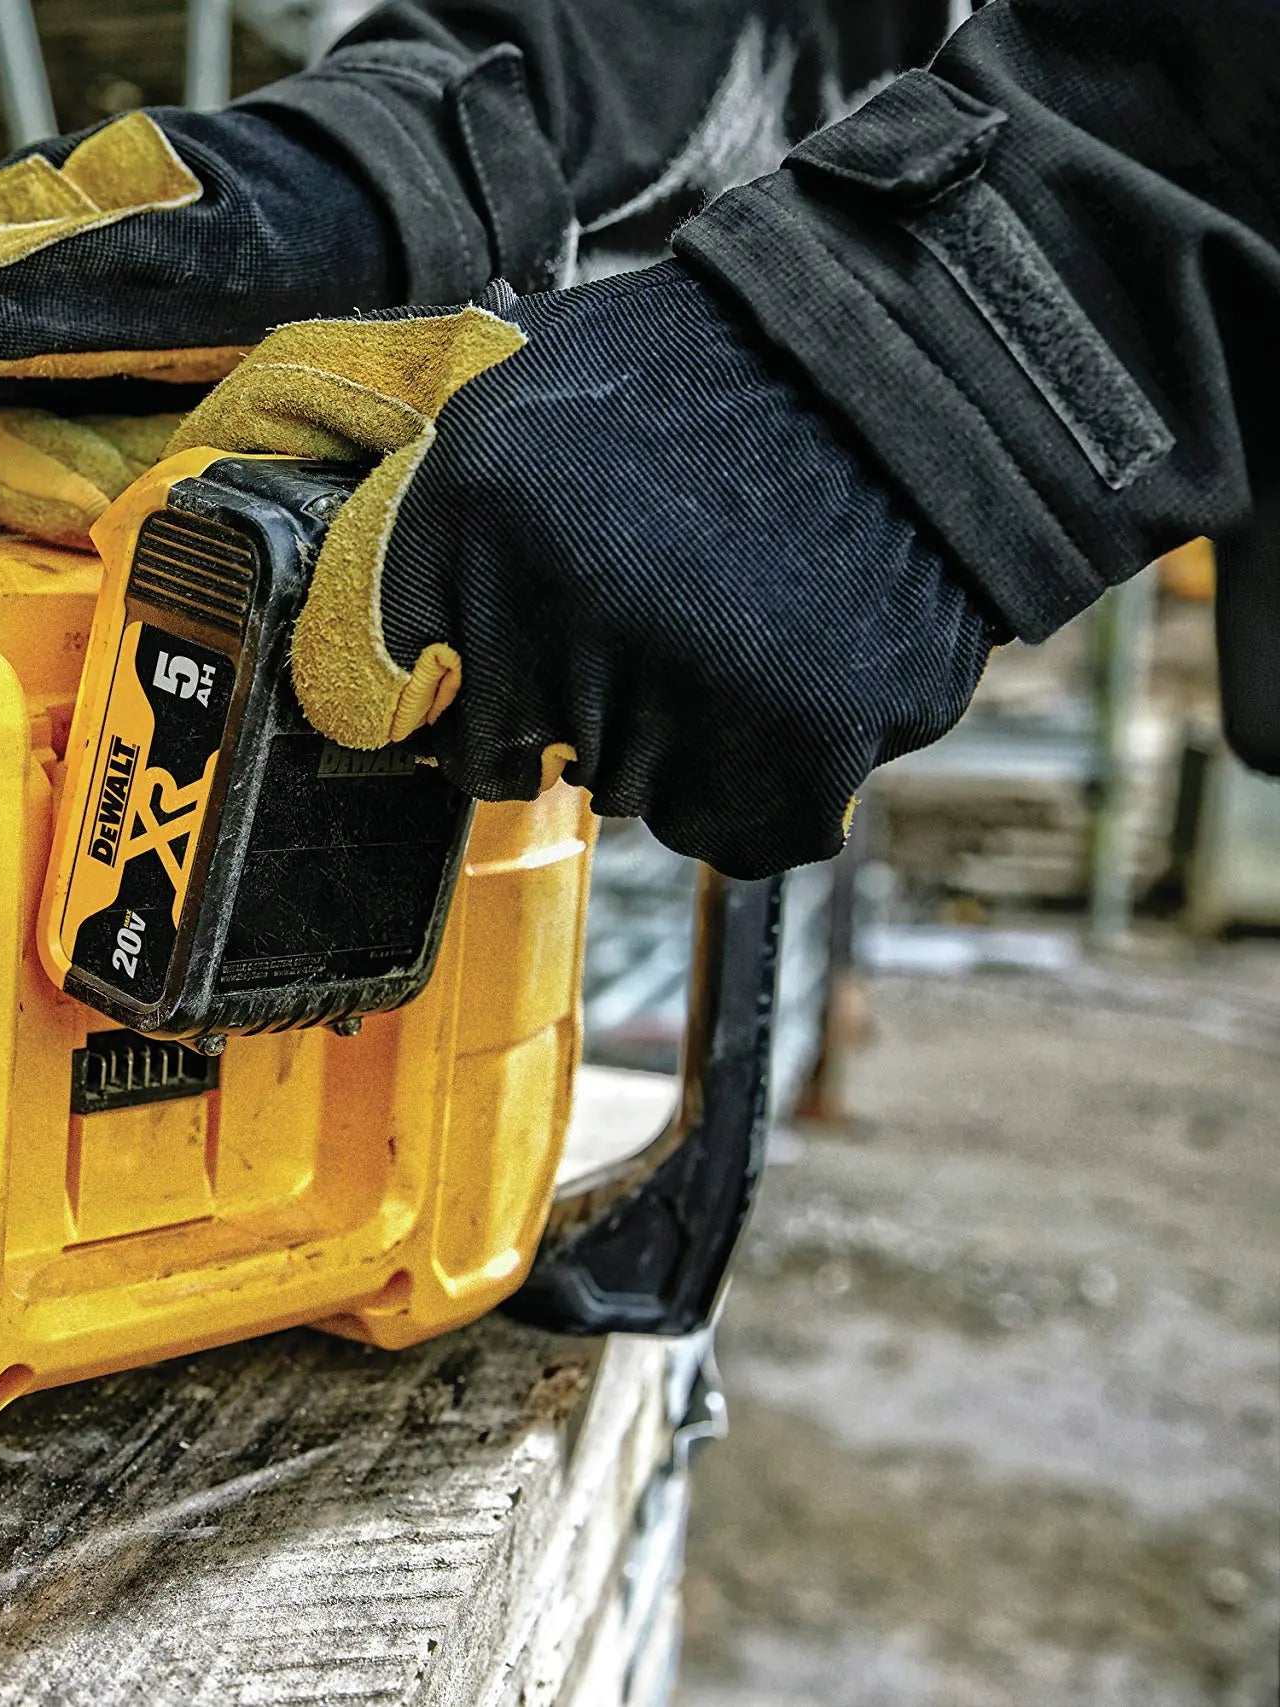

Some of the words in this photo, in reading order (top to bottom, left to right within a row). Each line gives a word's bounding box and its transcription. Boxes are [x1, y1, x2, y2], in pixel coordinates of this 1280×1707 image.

[153, 650, 199, 698] 5
[196, 663, 217, 708] AH
[91, 737, 137, 867] DEWALT
[122, 765, 210, 895] XR
[112, 911, 147, 979] 20V
[123, 909, 132, 928] MAX
